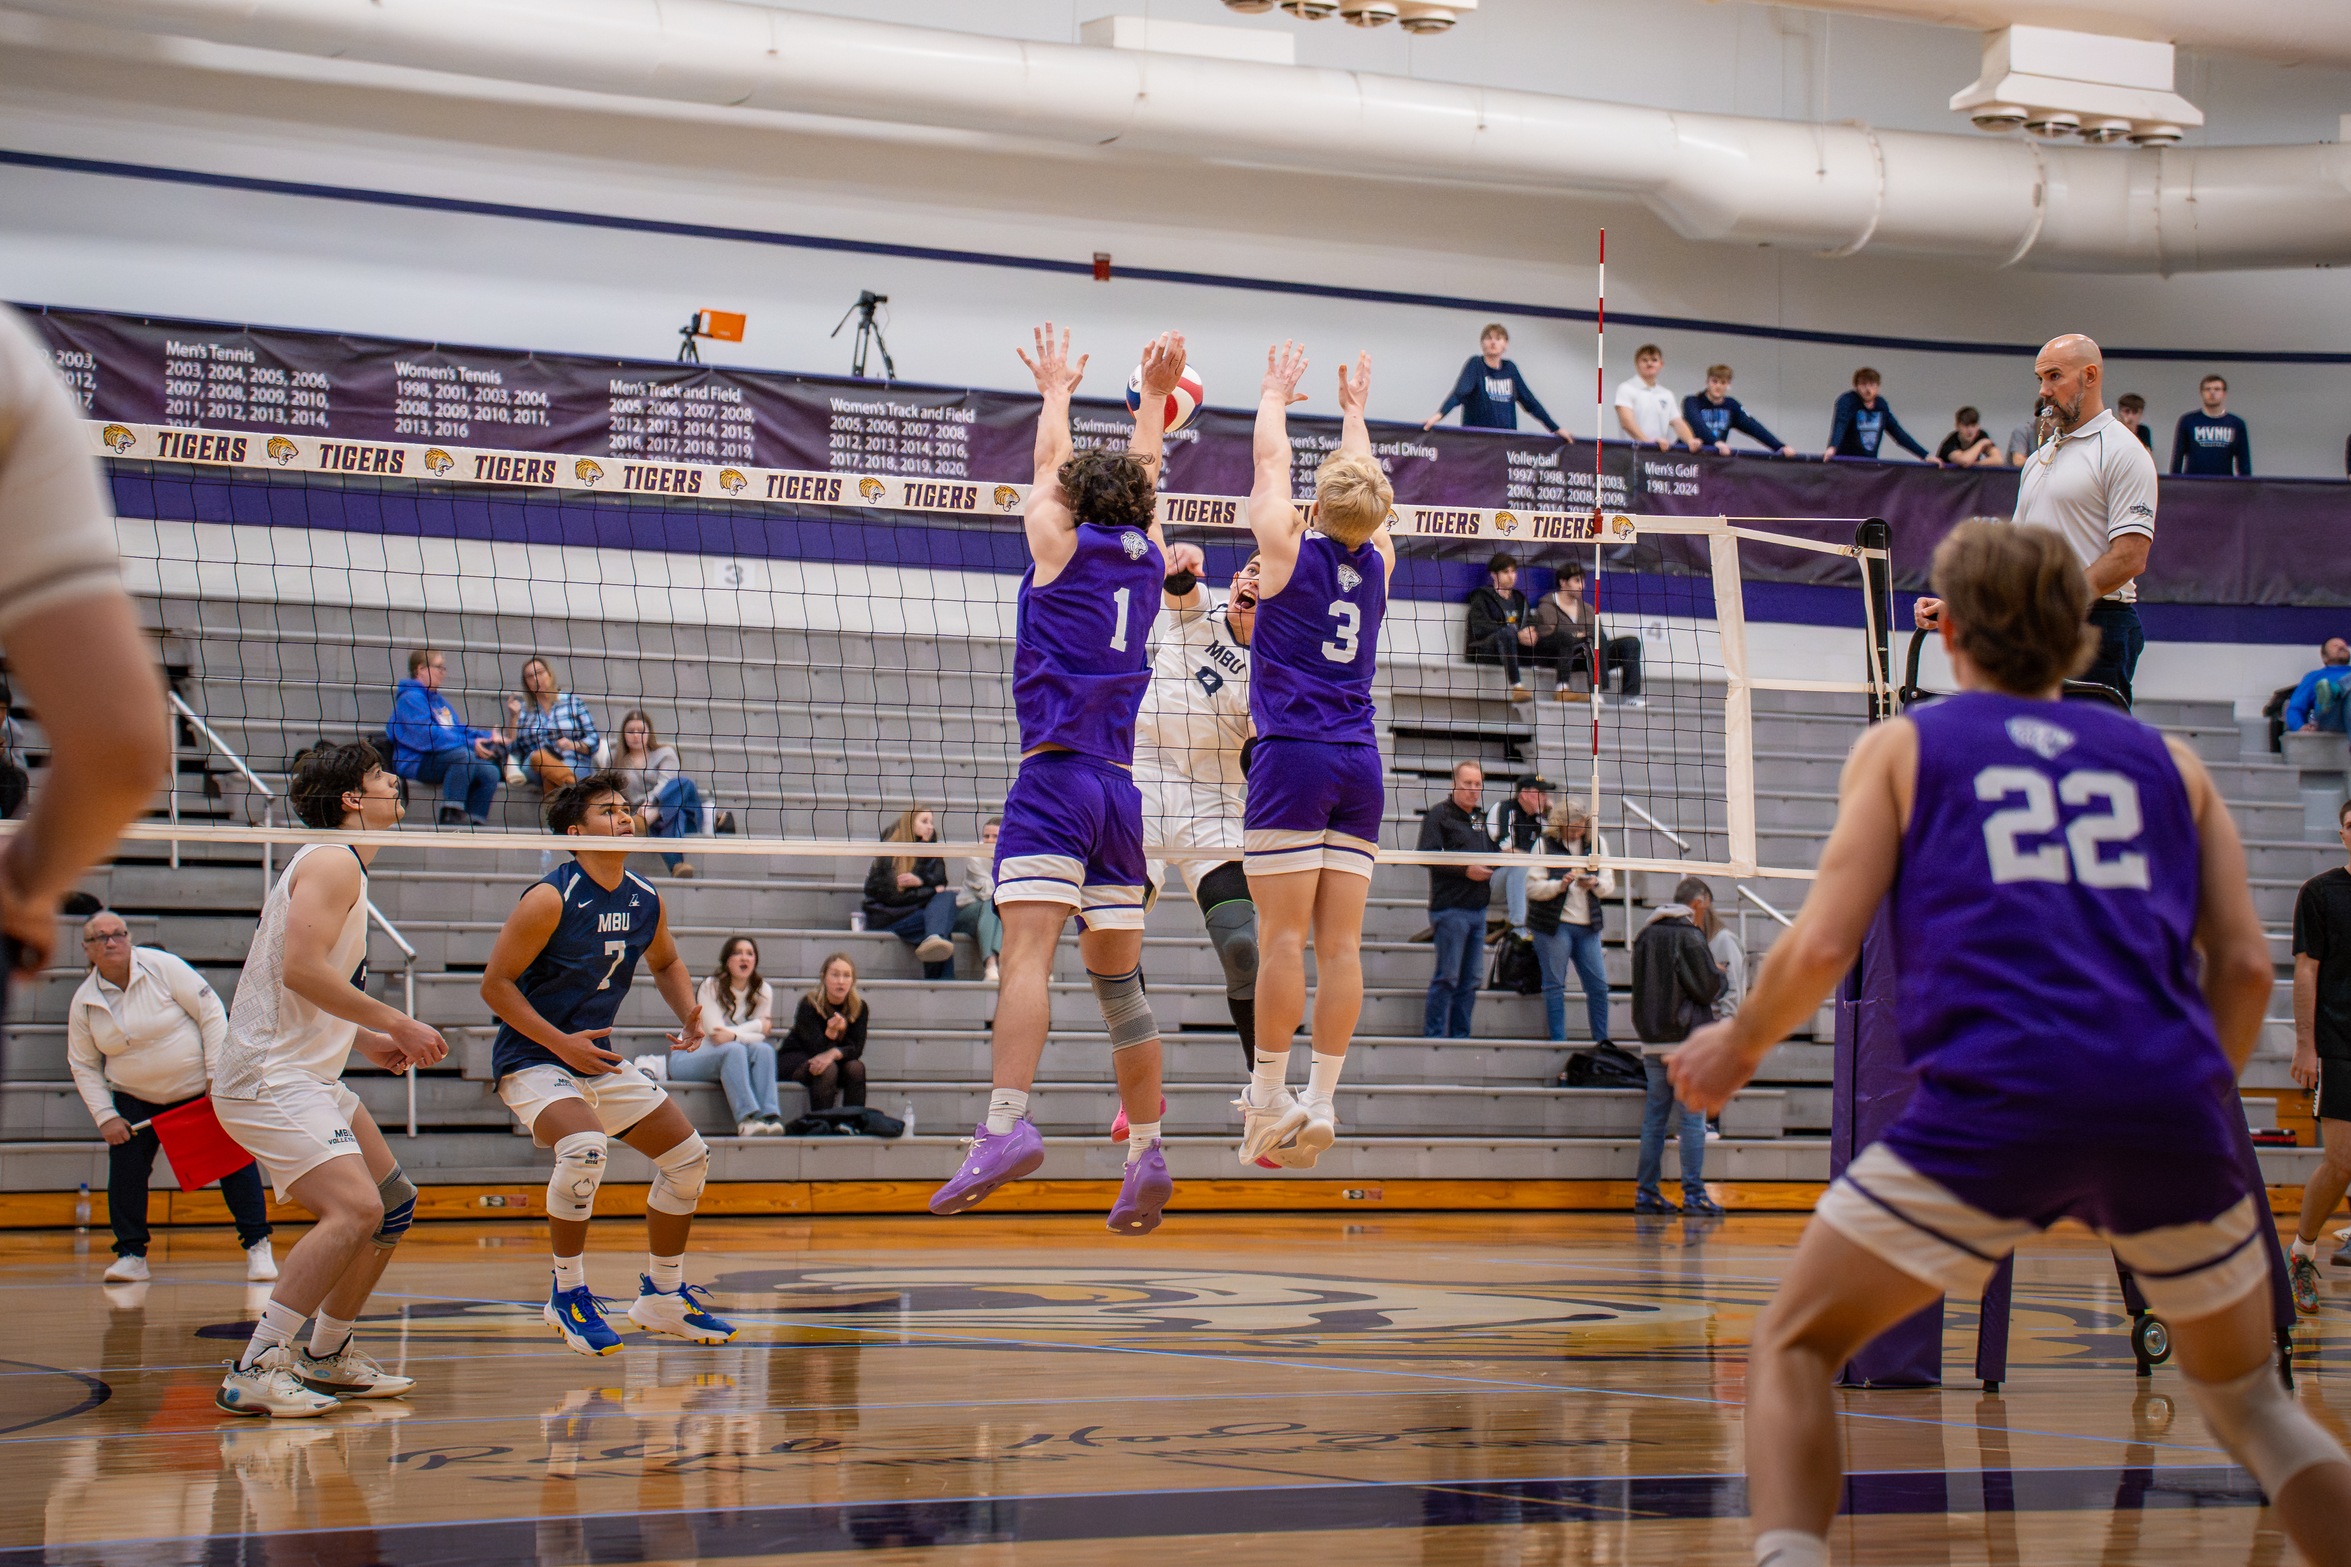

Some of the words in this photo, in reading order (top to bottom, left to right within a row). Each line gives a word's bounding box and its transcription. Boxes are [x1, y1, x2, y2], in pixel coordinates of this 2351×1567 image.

[166, 340, 207, 359] Men's
[209, 343, 256, 363] Tennis
[165, 360, 204, 379] 2003,
[207, 363, 246, 383] 2004,
[250, 367, 288, 387] 2005,
[291, 371, 331, 390] 2006,
[394, 361, 456, 381] Women's
[458, 366, 502, 385] Tennis
[165, 379, 204, 399] 2007,
[207, 383, 246, 402] 2008,
[250, 386, 288, 406] 2009,
[291, 390, 330, 410] 2010,
[609, 379, 646, 396] Men's
[648, 381, 682, 398] Track
[684, 385, 708, 400] and
[710, 386, 742, 403] Field
[165, 399, 204, 419] 2011,
[207, 403, 246, 422] 2012,
[249, 406, 287, 426] 2013,
[291, 409, 329, 429] 2014,
[829, 397, 886, 416] Women's
[887, 401, 919, 418] Track
[920, 406, 944, 421] and
[945, 406, 976, 424] Field
[395, 418, 432, 437] 2013,
[435, 421, 469, 439] 2016
[1073, 417, 1135, 438] Swimming
[2194, 426, 2235, 442] MVNU
[1378, 442, 1399, 456] and
[1402, 442, 1438, 462] Diving
[1507, 450, 1559, 469] Volleyball
[1645, 461, 1674, 477] Men's
[1675, 463, 1698, 479] Golf
[157, 431, 247, 463] TIGERS
[319, 443, 405, 474] TIGERS
[474, 455, 557, 484] TIGERS
[623, 465, 702, 494] TIGERS
[766, 474, 842, 501] TIGERS
[903, 483, 977, 510] TIGERS
[1166, 498, 1237, 524] TIGERS
[1415, 510, 1481, 535] TIGERS
[724, 564, 744, 584] 3
[1109, 587, 1130, 652] 1
[1321, 599, 1361, 664] 3
[1204, 639, 1246, 675] MBU
[1973, 765, 2152, 891] 22
[597, 912, 630, 933] MBU
[597, 940, 626, 990] 7
